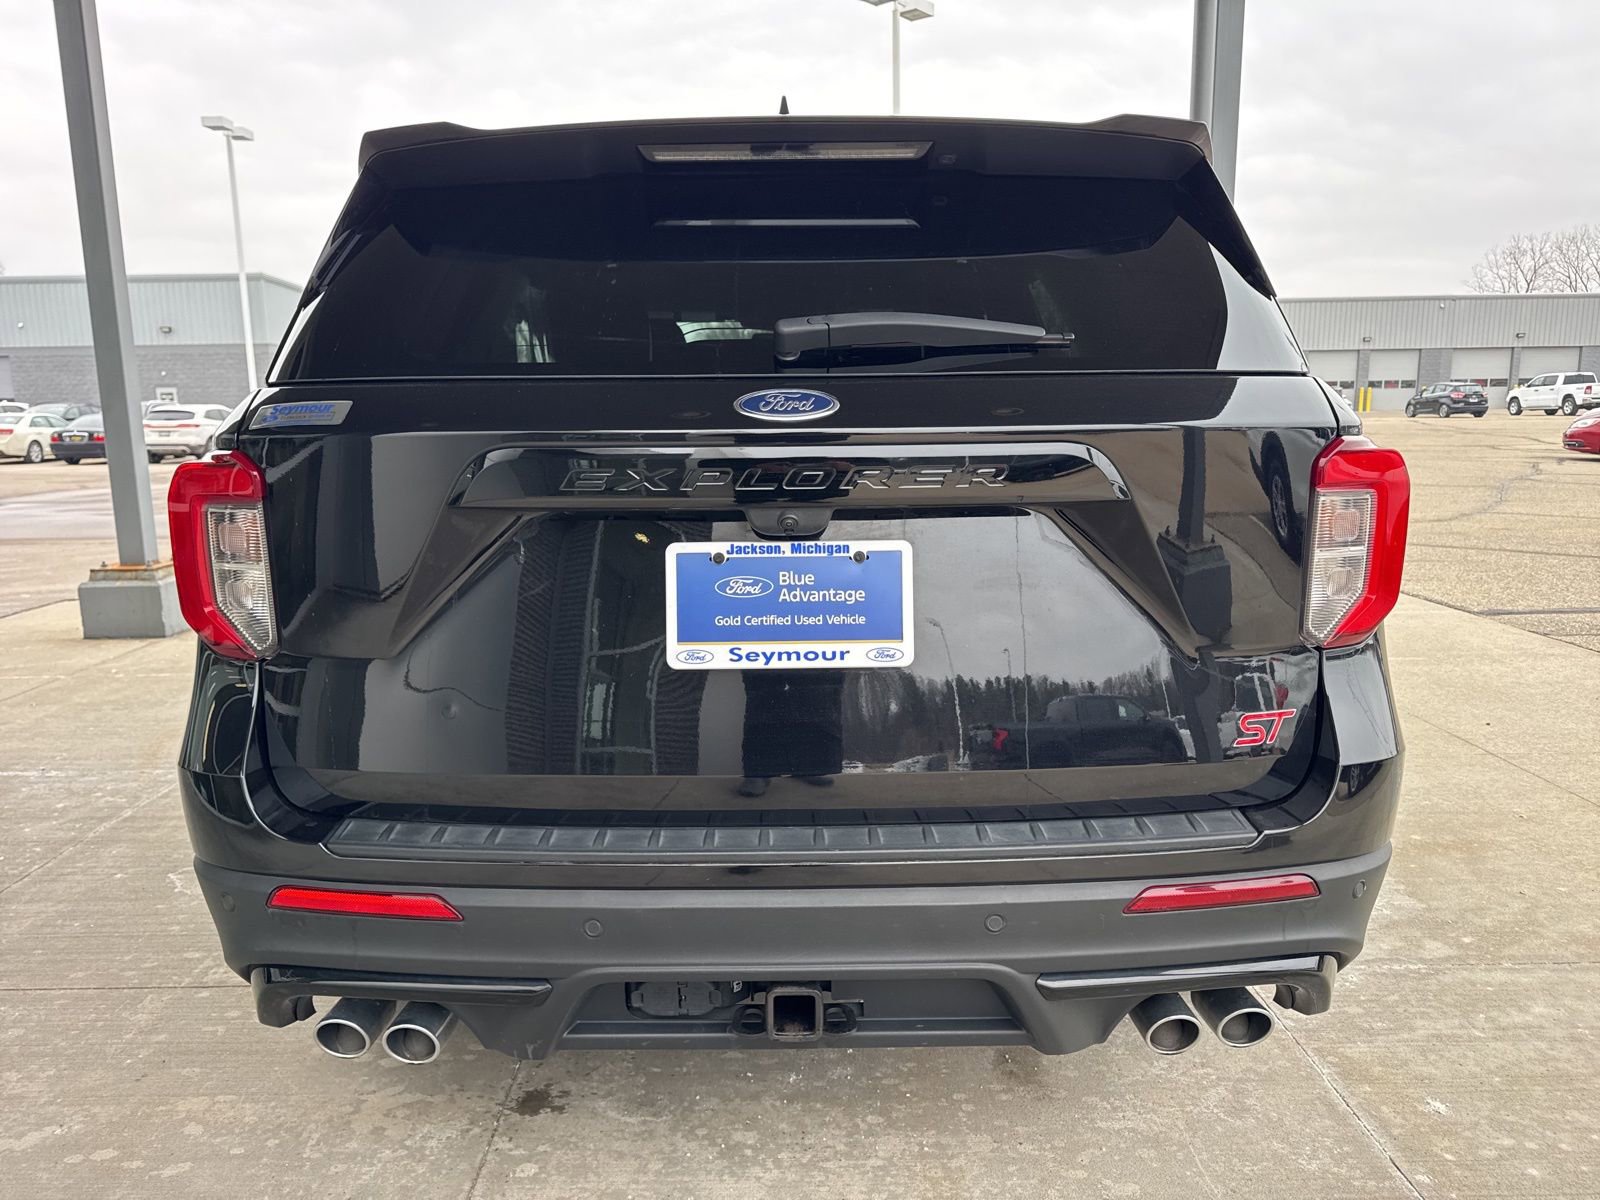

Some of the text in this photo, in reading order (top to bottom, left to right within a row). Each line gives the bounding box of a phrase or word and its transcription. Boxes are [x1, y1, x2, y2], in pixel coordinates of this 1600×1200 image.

[270, 404, 335, 416] Seymour
[758, 393, 816, 413] Ford
[559, 464, 1010, 491] EXPLORER
[726, 543, 850, 556] Jackson, Michigan
[725, 579, 762, 594] Ford
[778, 571, 815, 586] Blue
[778, 588, 866, 605] Advantage
[714, 614, 866, 626] Gold Certified Used Vehicle
[728, 647, 850, 665] Seymour
[1233, 708, 1297, 747] ST
